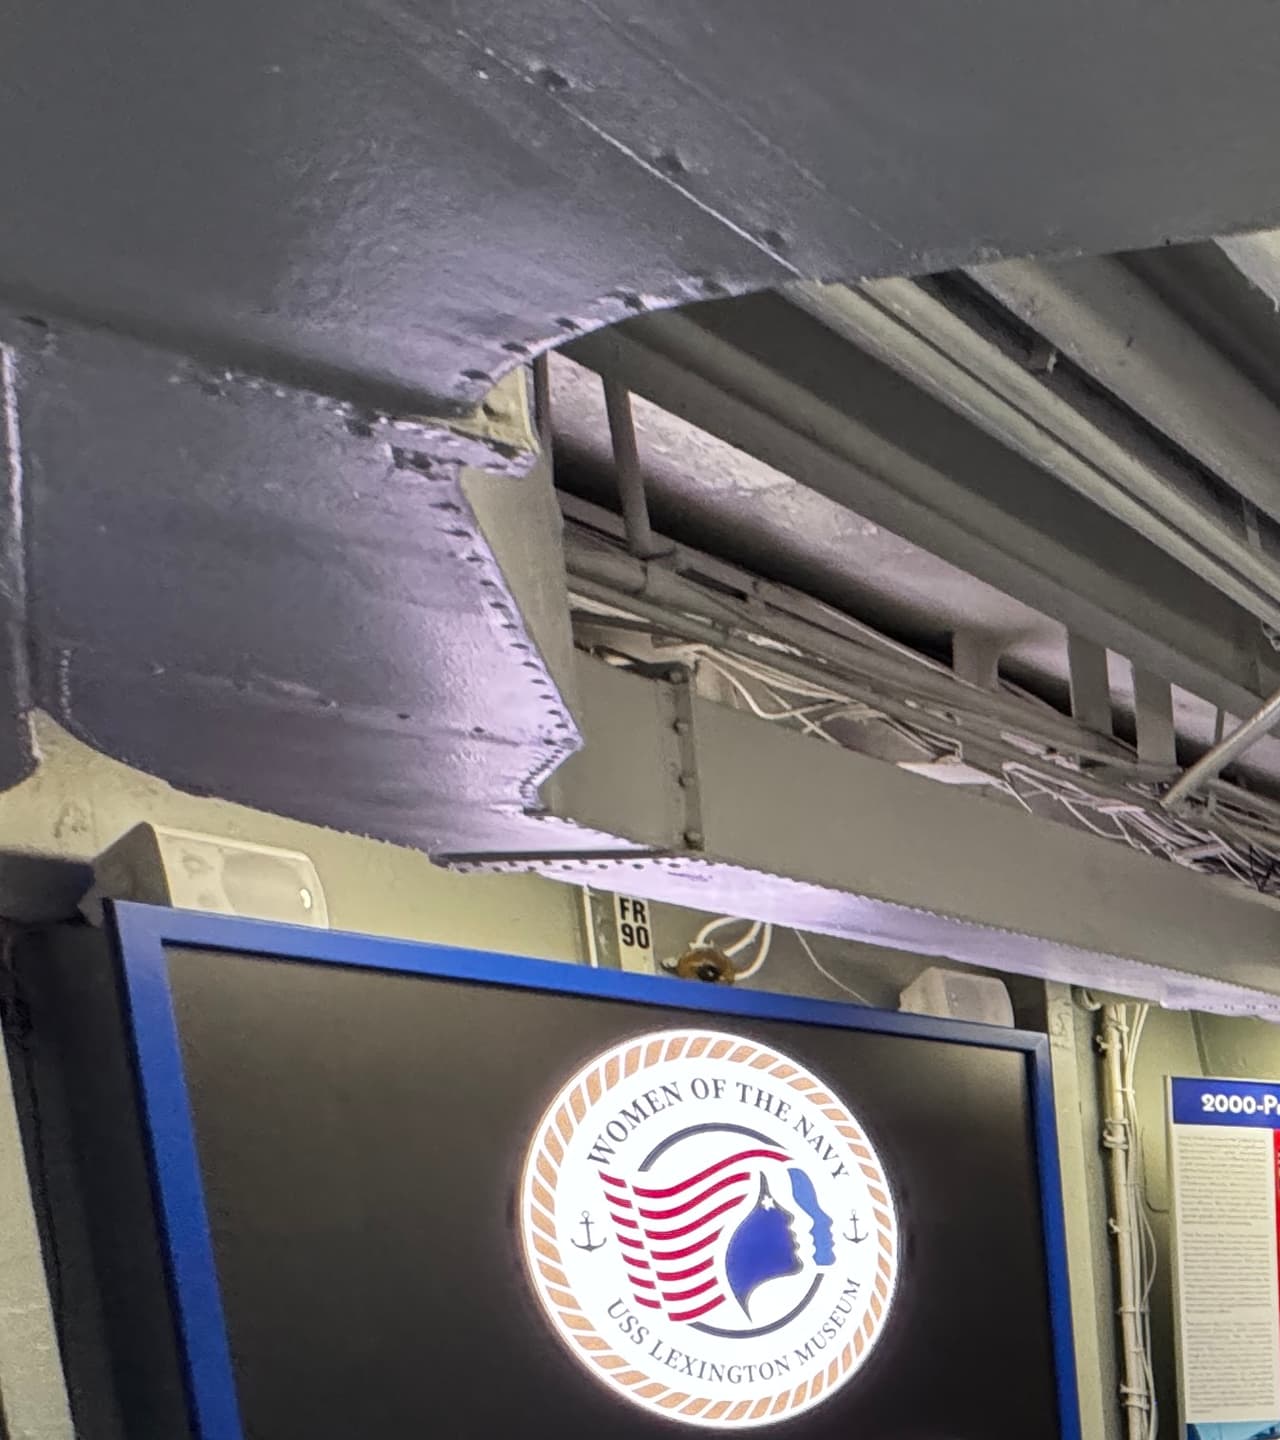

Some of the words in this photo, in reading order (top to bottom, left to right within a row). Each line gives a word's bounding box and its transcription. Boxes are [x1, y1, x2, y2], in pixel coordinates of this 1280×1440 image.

[620, 895, 646, 924] FR
[621, 923, 650, 950] 90
[587, 1081, 684, 1167] WOMEN
[690, 1077, 727, 1100] OF
[736, 1081, 792, 1122] THE
[793, 1115, 849, 1178] NAVY
[607, 1298, 650, 1345] USS
[648, 1339, 792, 1384] LEXINGTON
[794, 1278, 861, 1366] MUSEUM
